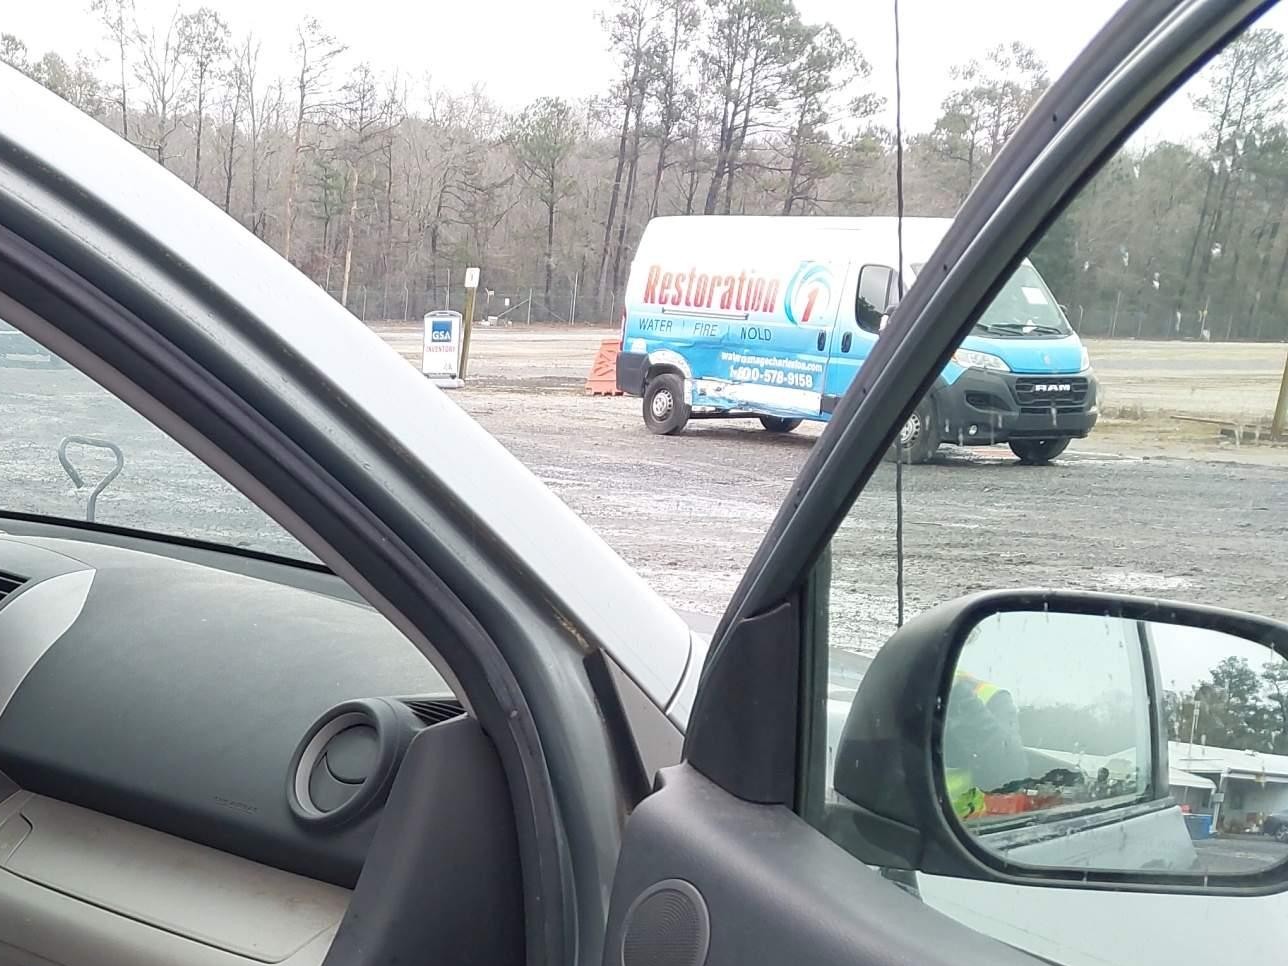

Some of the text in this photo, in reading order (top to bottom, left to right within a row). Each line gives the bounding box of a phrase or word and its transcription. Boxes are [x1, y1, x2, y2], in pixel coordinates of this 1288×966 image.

[643, 265, 779, 313] Restoration
[433, 331, 450, 340] GSA
[639, 318, 673, 333] WATER
[693, 322, 719, 337] FIRE
